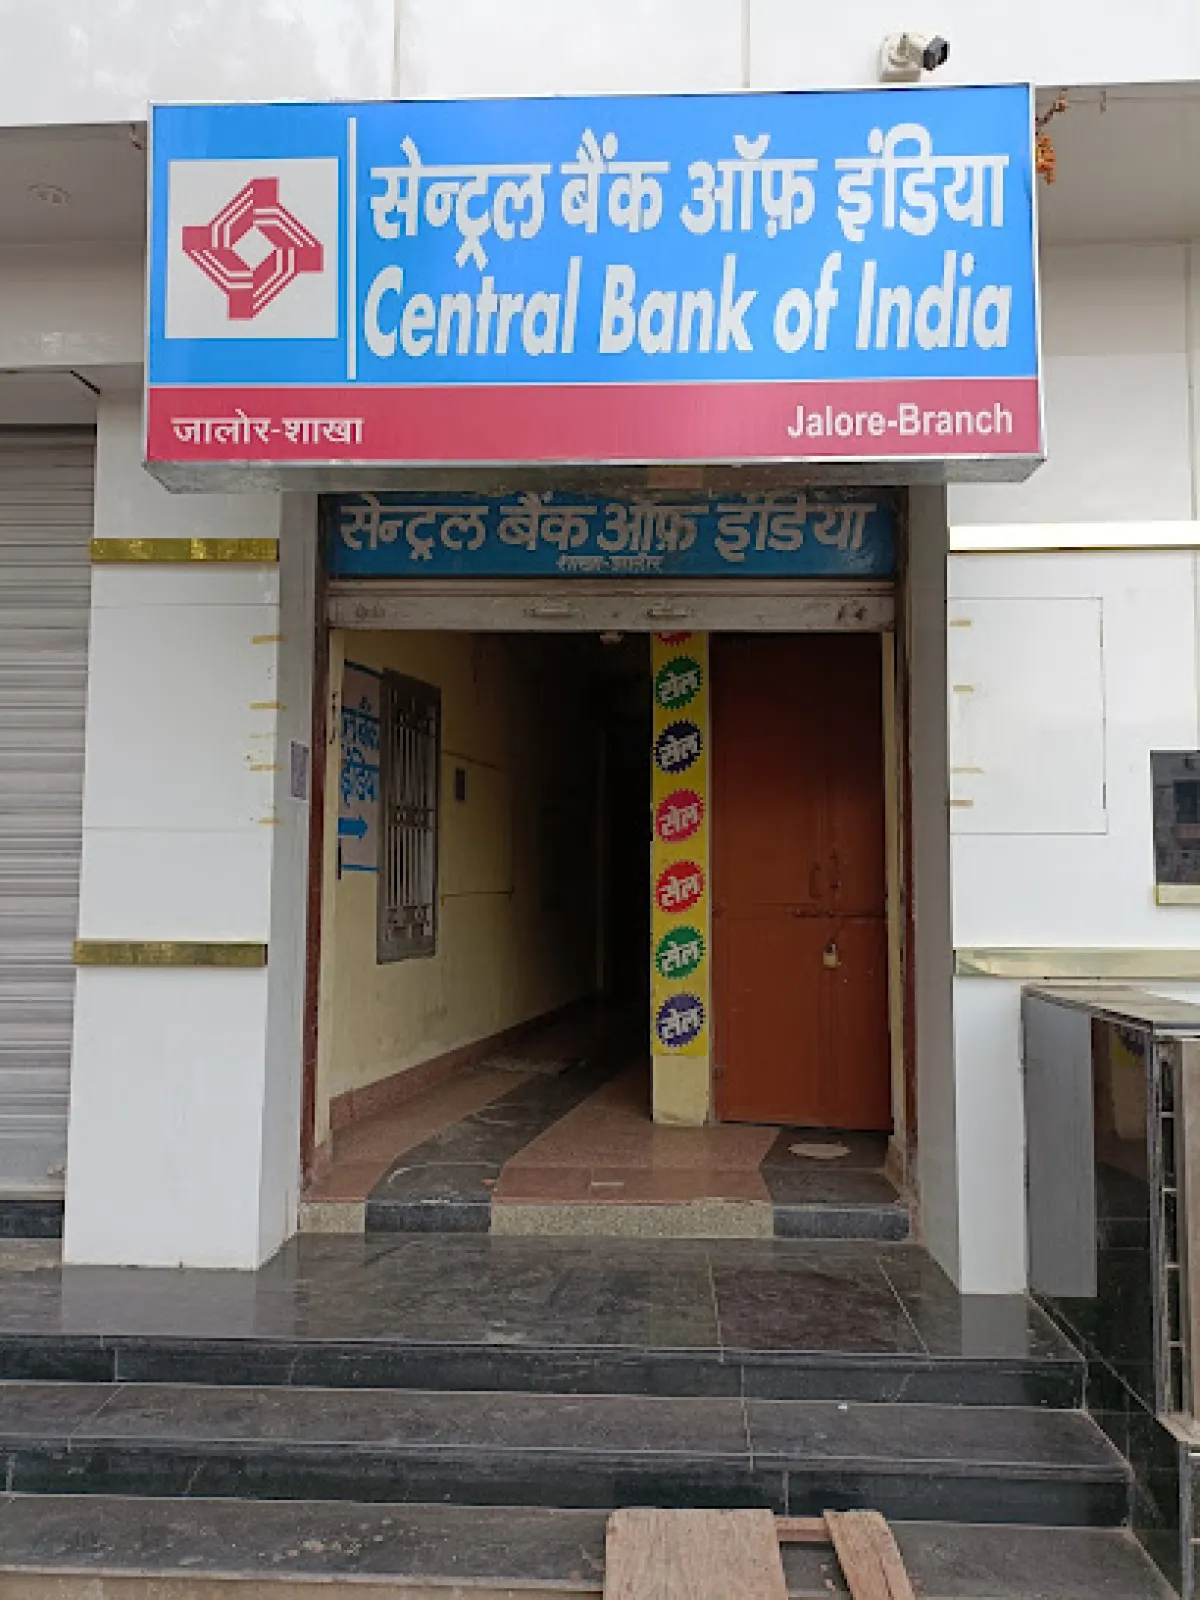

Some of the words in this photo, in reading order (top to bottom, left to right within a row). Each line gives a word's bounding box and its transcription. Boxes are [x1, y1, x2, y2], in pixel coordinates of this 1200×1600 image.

[371, 136, 552, 271] सेन्ट्रल
[560, 129, 670, 233] बैंक
[680, 134, 819, 239] ऑफ़
[834, 123, 1010, 242] इंडिया
[364, 256, 583, 358] Central
[599, 252, 759, 354] Bank
[773, 250, 842, 354] of
[855, 249, 1013, 351] India
[170, 408, 364, 445] जालोर-शाखा
[787, 402, 1013, 439] Jalore-Branch
